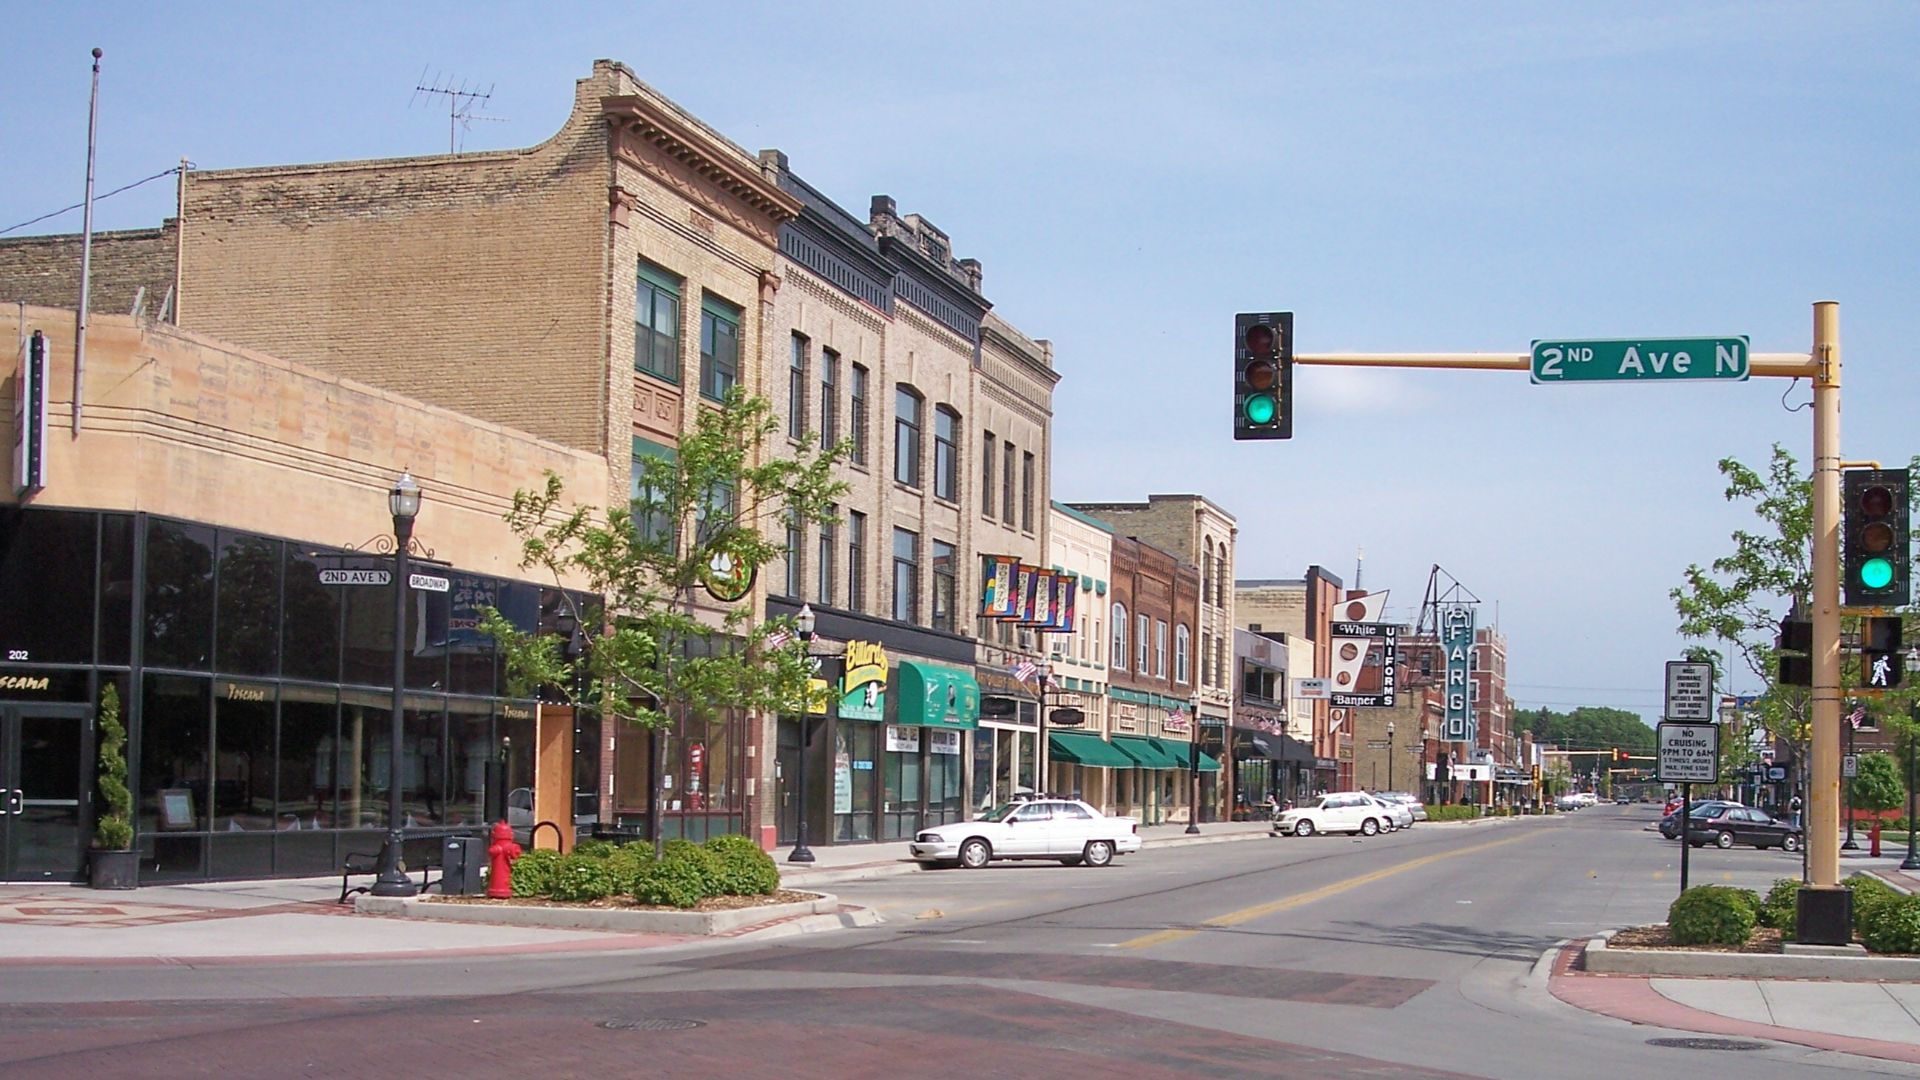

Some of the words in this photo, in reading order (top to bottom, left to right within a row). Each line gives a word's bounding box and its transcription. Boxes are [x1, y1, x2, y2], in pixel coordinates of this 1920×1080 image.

[1541, 348, 1593, 375] 2ND
[1618, 346, 1692, 374] Ave
[1715, 344, 1739, 372] N
[324, 571, 348, 583] 2ND
[352, 572, 374, 583] AVE
[378, 573, 387, 583] N
[411, 575, 447, 590] BROADWAY
[1339, 624, 1376, 635] White
[8, 650, 29, 660] 202
[1383, 627, 1395, 706] UNIFORMS
[1450, 624, 1465, 735] FARGO
[1333, 695, 1377, 706] Banner
[1682, 730, 1694, 738] NO
[1668, 739, 1707, 748] CRUISING
[1682, 749, 1693, 757] TO
